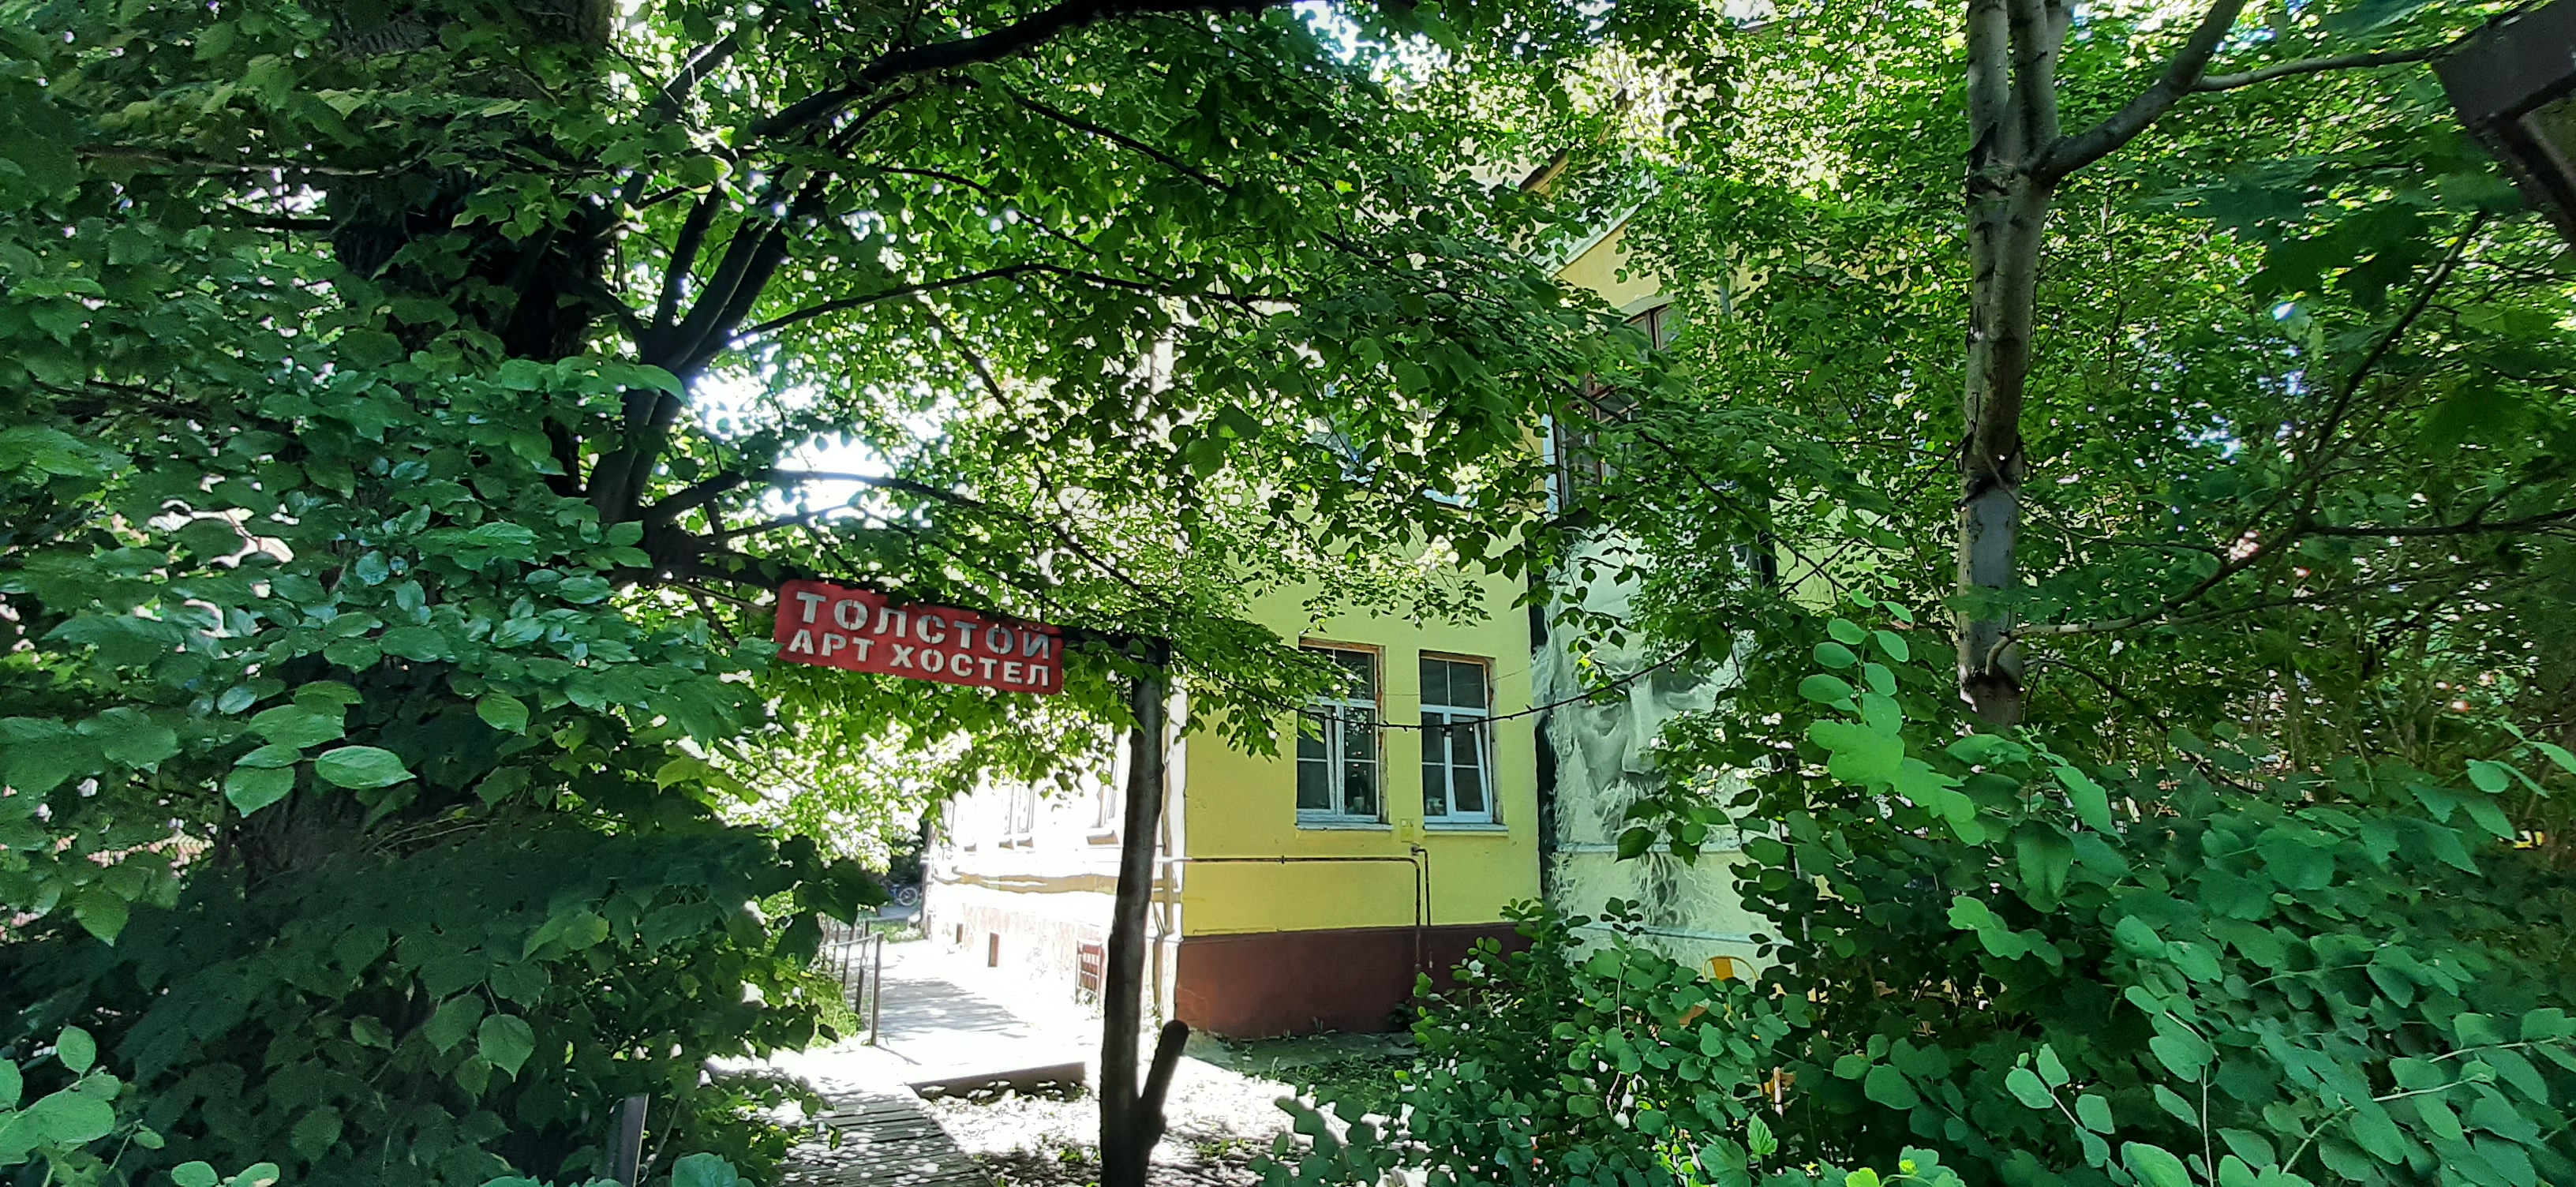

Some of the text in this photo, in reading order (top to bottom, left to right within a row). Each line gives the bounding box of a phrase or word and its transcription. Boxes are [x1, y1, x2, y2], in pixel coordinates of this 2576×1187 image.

[788, 628, 1049, 687] АРТ ХОСТЕЛ
[796, 591, 1050, 660] ТОЛСТОЙ
